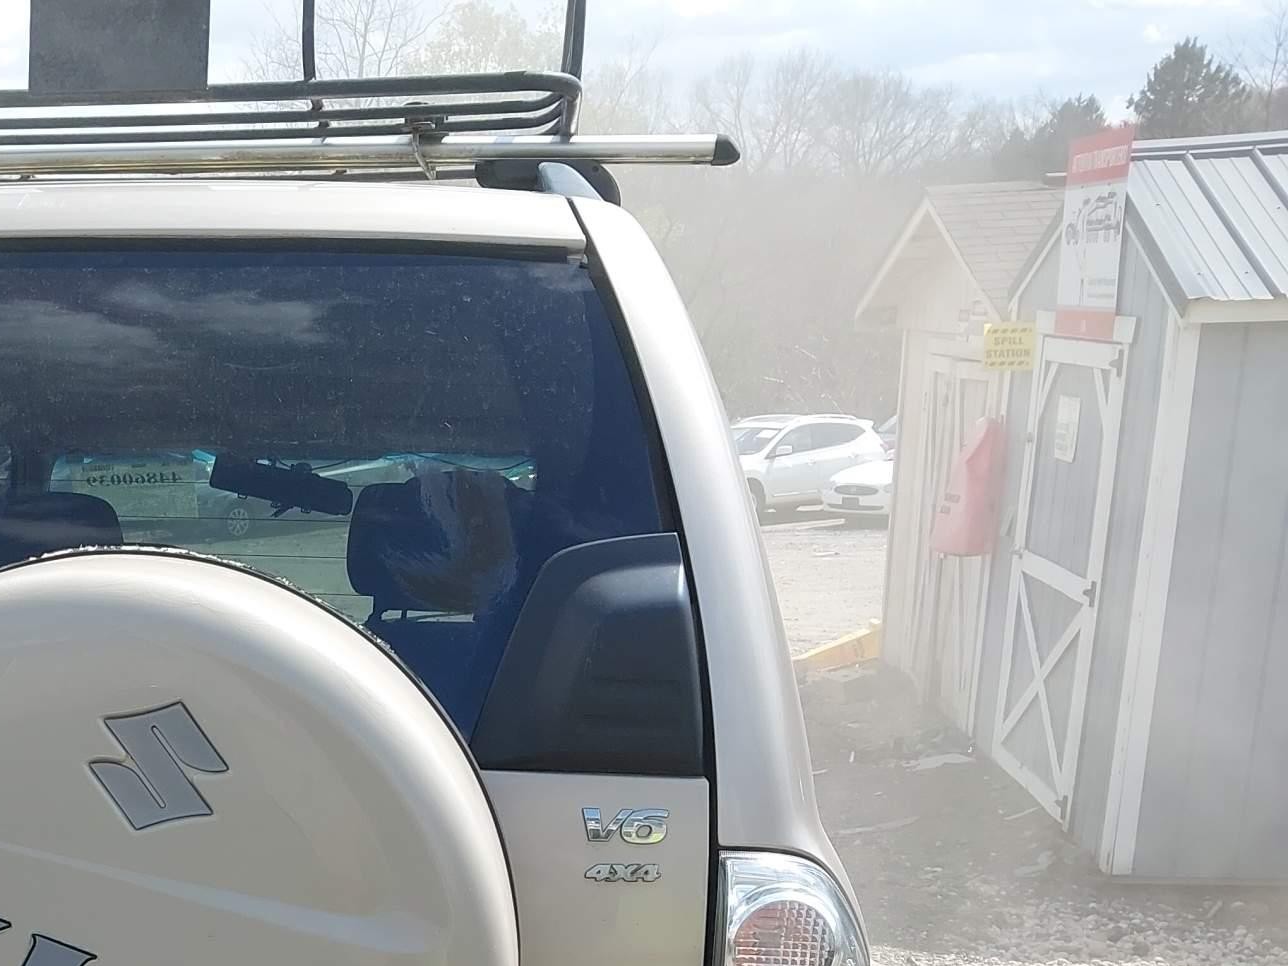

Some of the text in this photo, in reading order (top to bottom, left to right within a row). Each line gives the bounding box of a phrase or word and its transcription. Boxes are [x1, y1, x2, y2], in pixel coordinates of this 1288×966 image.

[993, 336, 1025, 346] SPILL
[985, 348, 1031, 359] STATION
[581, 806, 670, 845] V6
